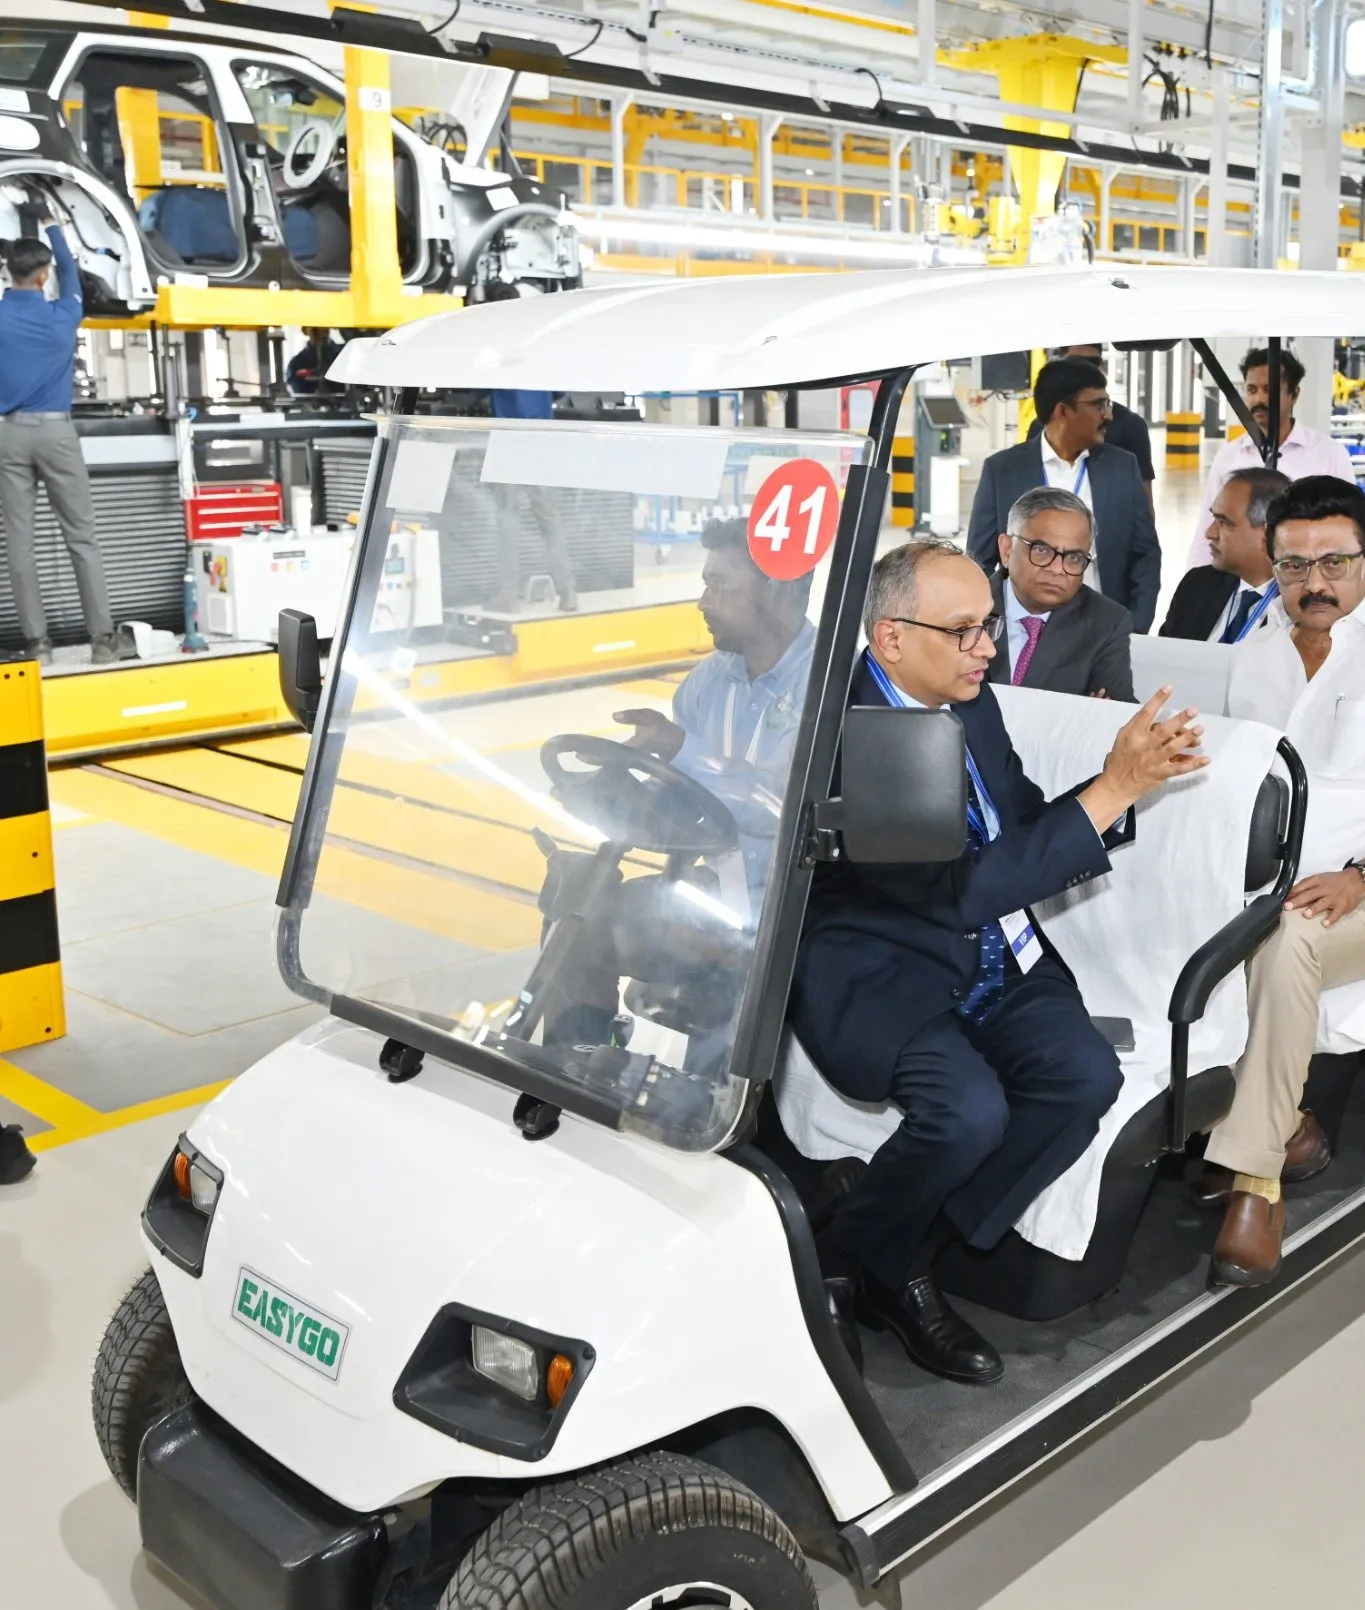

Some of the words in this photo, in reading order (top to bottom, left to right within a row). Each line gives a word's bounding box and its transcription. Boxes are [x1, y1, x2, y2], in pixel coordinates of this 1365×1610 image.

[372, 91, 382, 108] 9
[754, 484, 827, 555] 41
[1018, 932, 1028, 946] VIP
[237, 1277, 341, 1367] EASYGO
